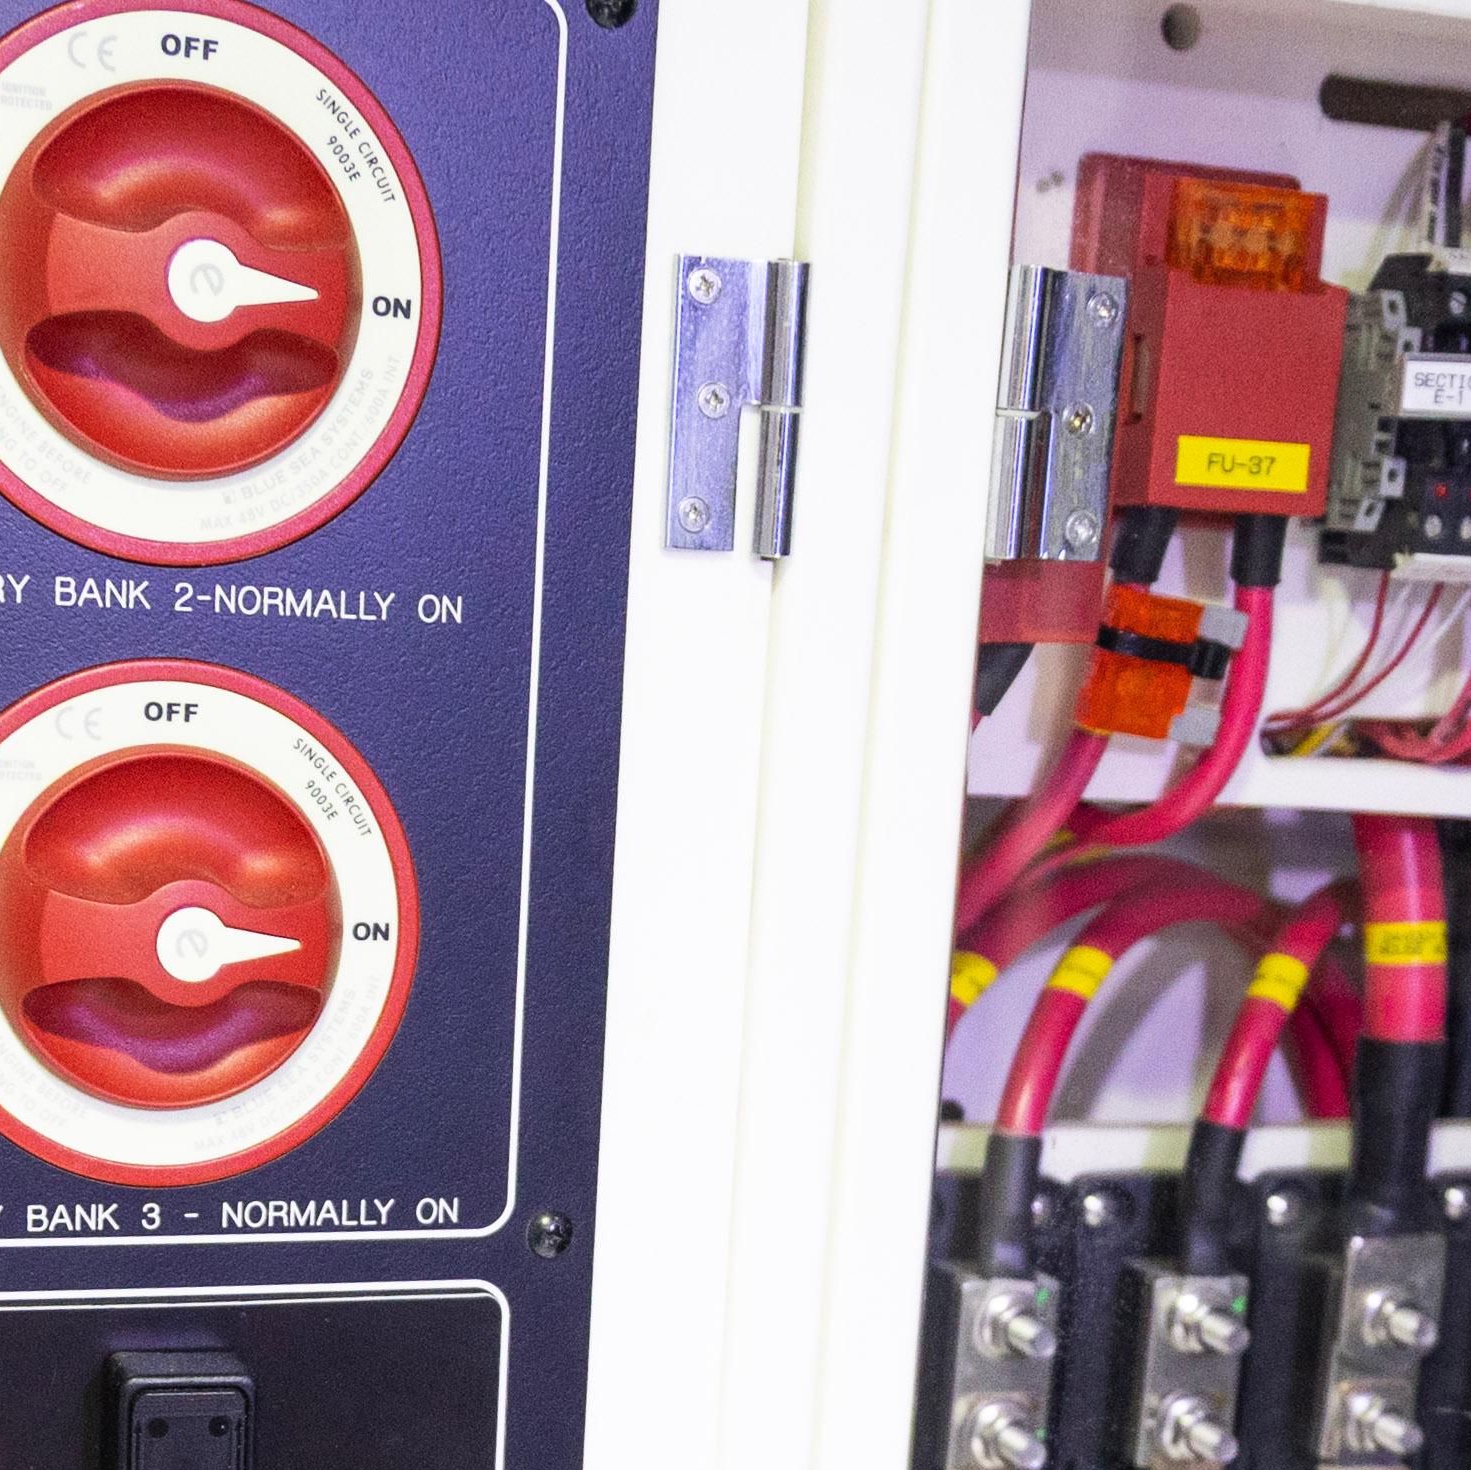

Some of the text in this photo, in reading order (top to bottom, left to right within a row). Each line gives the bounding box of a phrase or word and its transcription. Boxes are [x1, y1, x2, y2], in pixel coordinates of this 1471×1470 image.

[159, 32, 220, 62] OFF
[315, 88, 397, 204] SINGLE CIRCUIT
[326, 134, 362, 183] 9003E
[371, 294, 413, 321] ON
[1434, 388, 1464, 406] E-1
[240, 367, 375, 500] BLUE SEA SYSTEMS
[17, 450, 37, 471] TO
[39, 469, 69, 492] OFF
[37, 440, 92, 486] BEFORE
[1207, 452, 1276, 476] FU-37
[54, 575, 151, 610] BANK
[174, 582, 396, 621] 2-NORMALLY
[417, 593, 463, 624] ON
[142, 700, 200, 724] OFF
[292, 737, 373, 838] SINGLE CIRCUIT
[304, 778, 340, 823] 9003E
[351, 920, 391, 943] ON
[26, 1203, 120, 1233] BANK
[141, 1202, 161, 1231] 3
[221, 1198, 397, 1229] NORMALLY
[415, 1197, 459, 1225] ON
